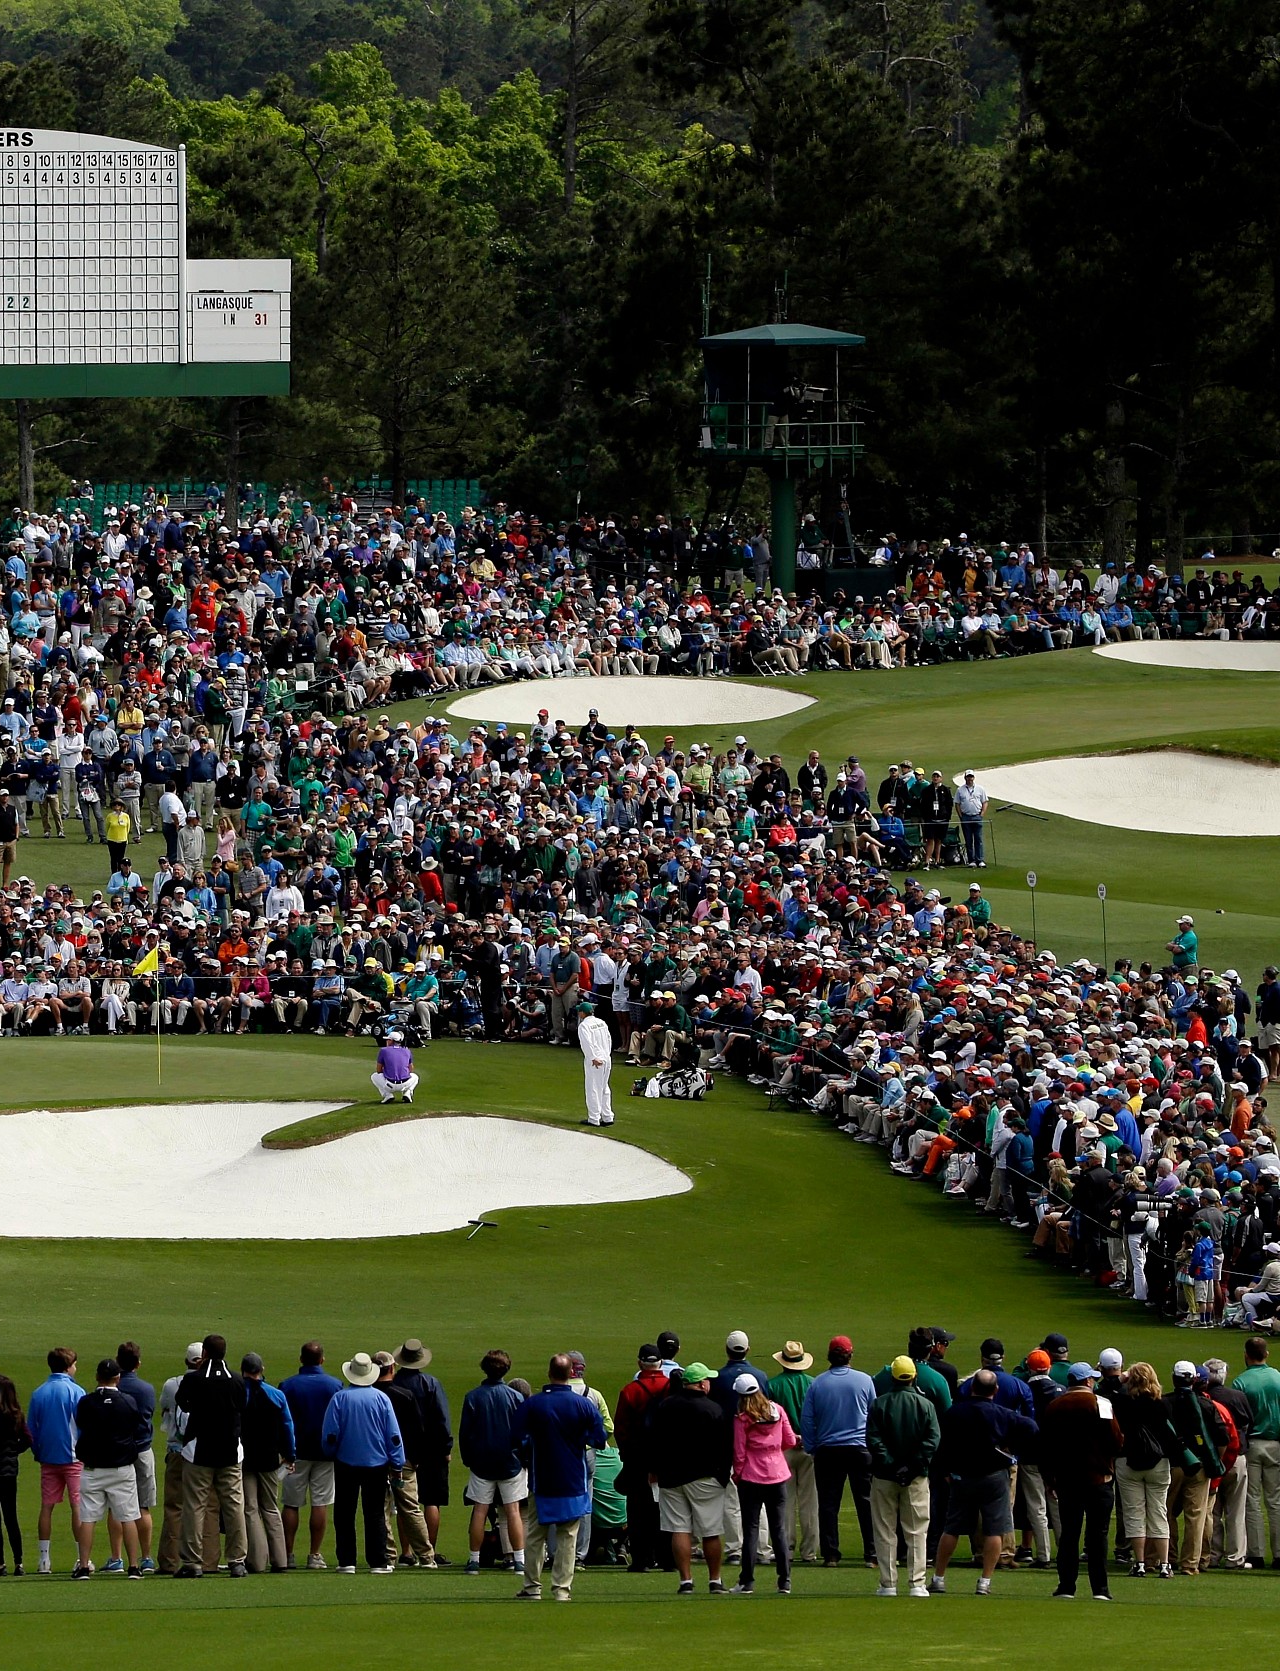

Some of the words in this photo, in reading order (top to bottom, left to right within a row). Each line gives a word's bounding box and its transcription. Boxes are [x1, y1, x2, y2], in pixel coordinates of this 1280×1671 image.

[7, 155, 13, 167] 8
[24, 155, 30, 167] 9
[39, 155, 50, 166] 10
[57, 155, 65, 166] 11
[71, 155, 81, 166] 12
[87, 155, 97, 166] 13
[102, 155, 112, 166] 14
[118, 155, 128, 166] 15
[133, 155, 143, 166] 16
[149, 155, 158, 166] 17
[164, 154, 175, 166] 18
[7, 173, 14, 184] 5
[23, 173, 30, 184] 4
[42, 173, 48, 184] 4
[57, 172, 63, 184] 4
[73, 172, 79, 184] 3
[89, 172, 94, 184] 5
[104, 173, 110, 184] 4
[120, 172, 126, 184] 5
[135, 172, 141, 183] 3
[150, 172, 156, 183] 4
[166, 172, 172, 183] 4
[7, 296, 14, 308] 2
[23, 296, 29, 308] 2
[197, 297, 253, 310] LANGASQUE
[255, 314, 266, 325] 31
[668, 1076, 698, 1092] RION
